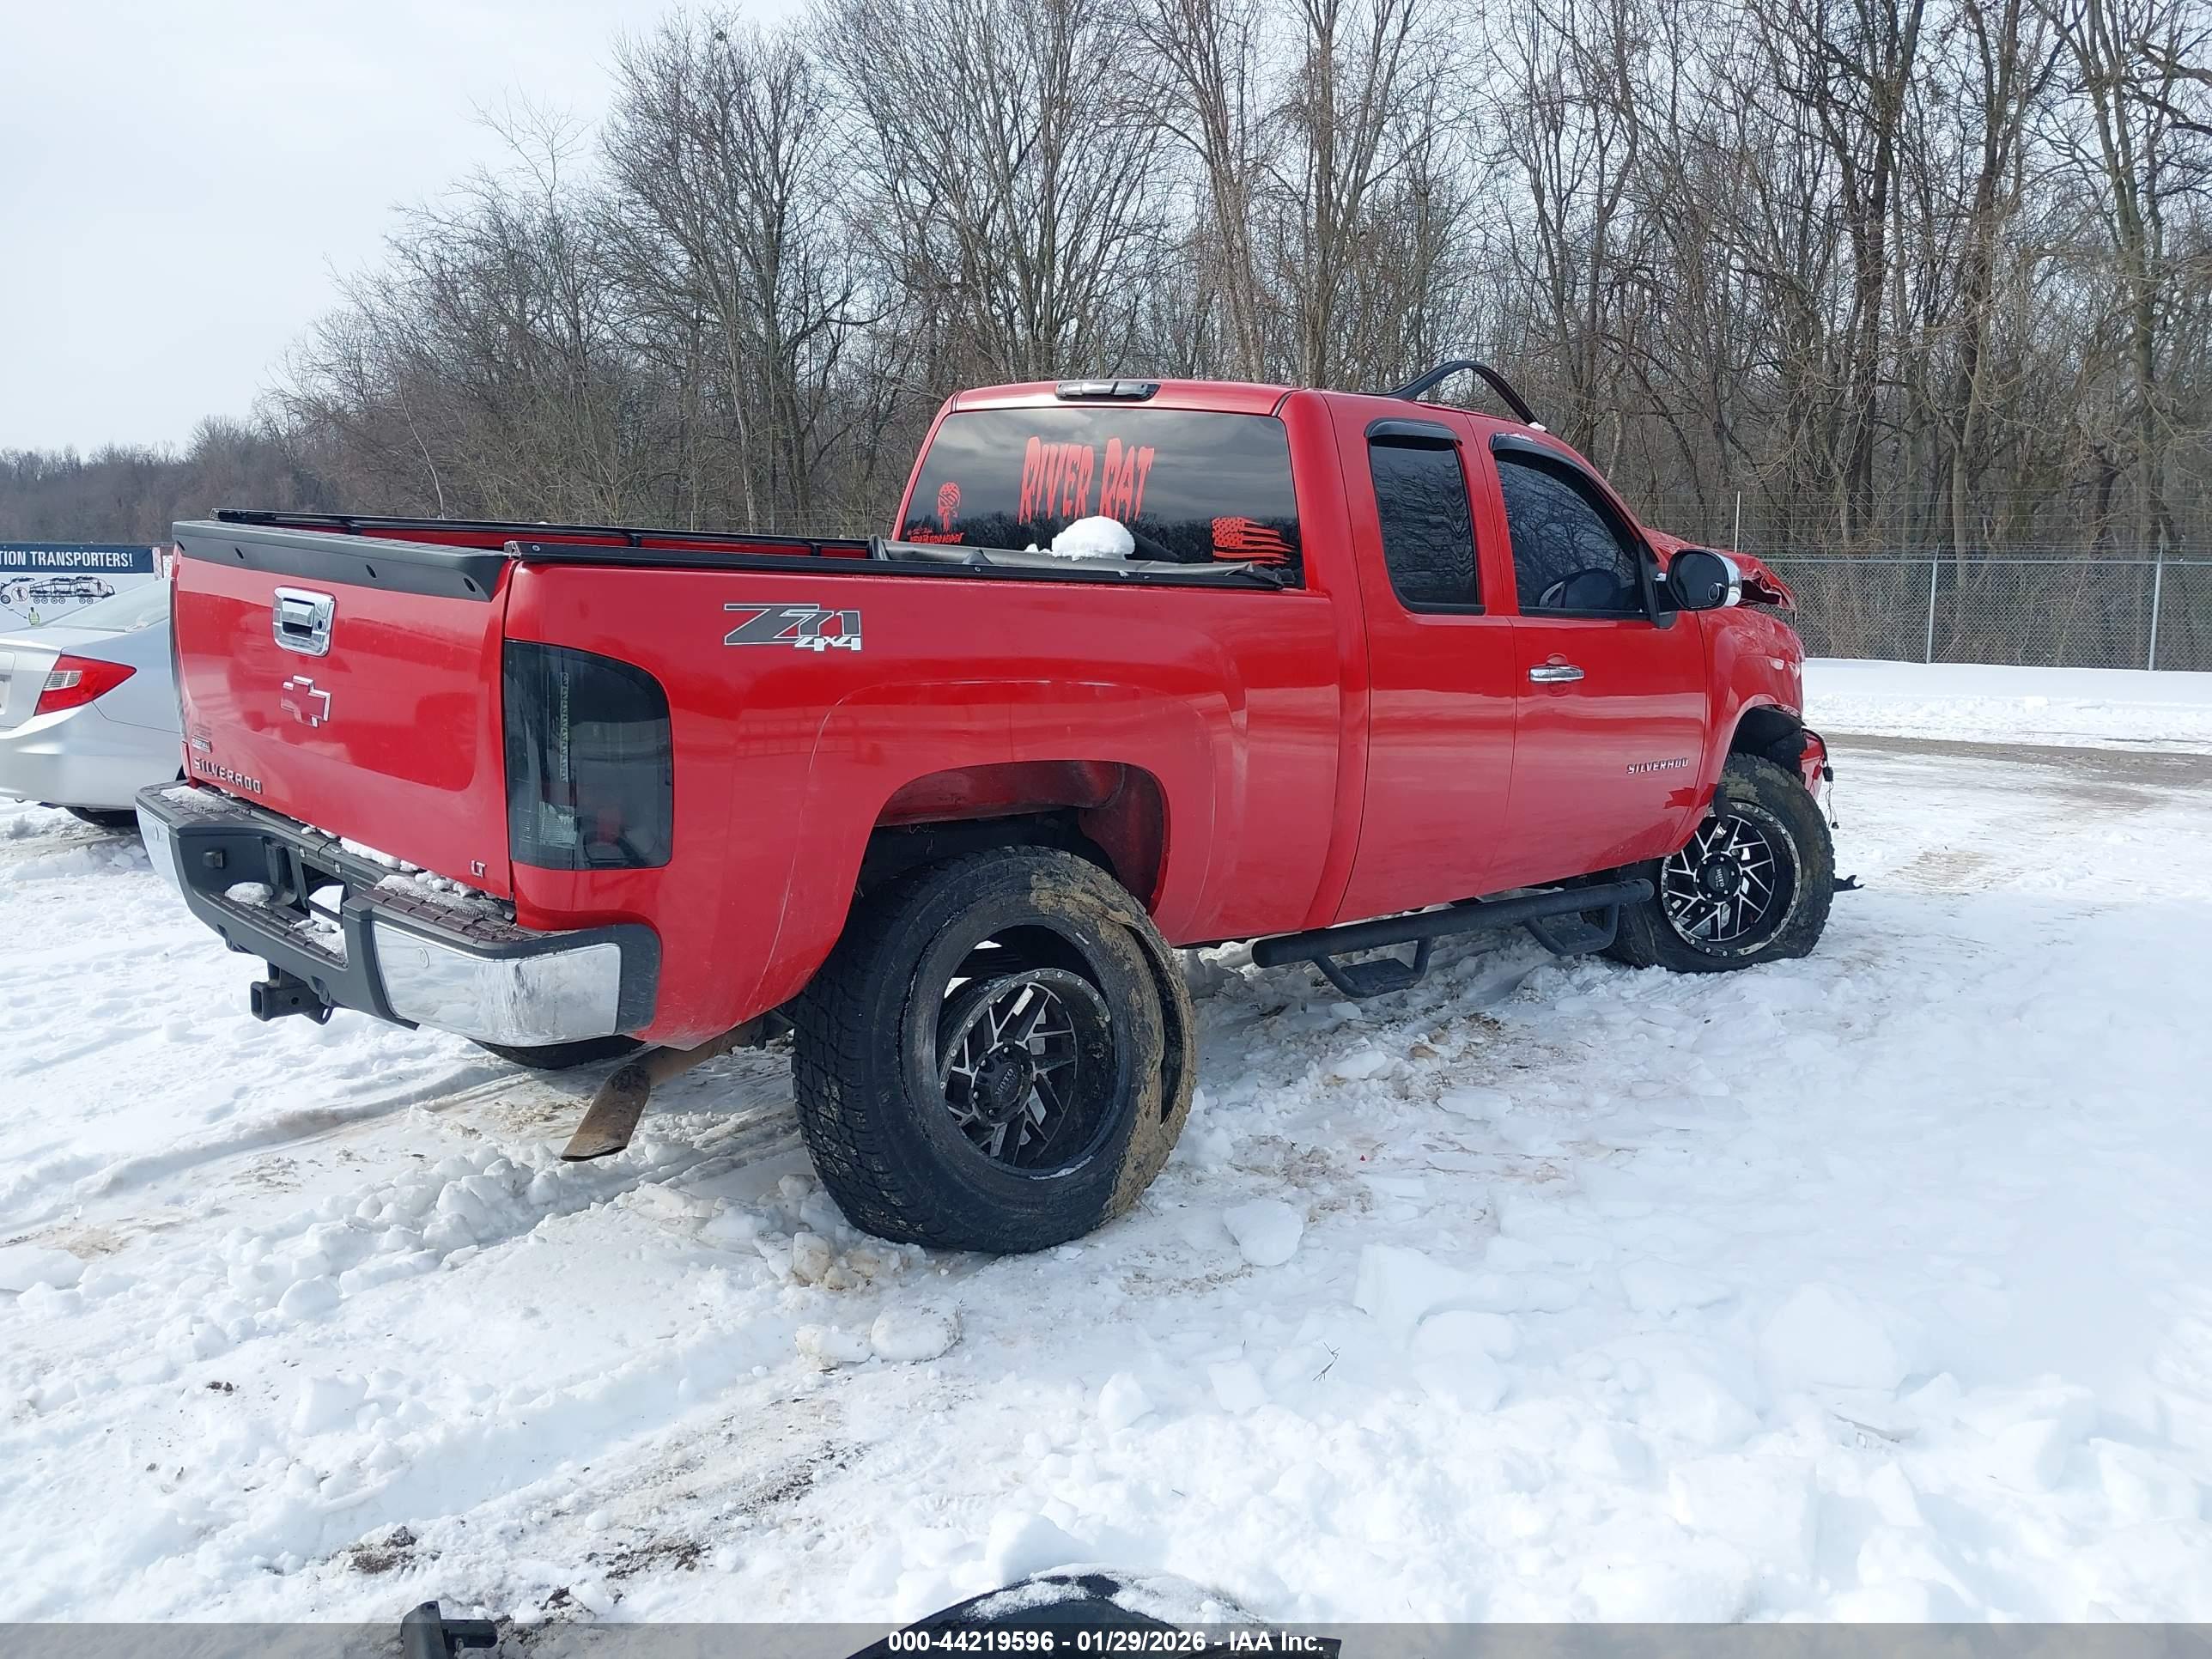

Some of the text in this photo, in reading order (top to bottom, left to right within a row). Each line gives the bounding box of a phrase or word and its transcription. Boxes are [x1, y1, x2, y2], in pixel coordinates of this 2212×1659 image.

[1018, 436, 1155, 526] RIVER RAT
[29, 550, 134, 567] TRANSPORTERS!
[724, 603, 861, 645] Z71
[193, 755, 263, 794] SILVERADO
[1626, 757, 1689, 775] SILVERADO
[471, 860, 487, 878] LT
